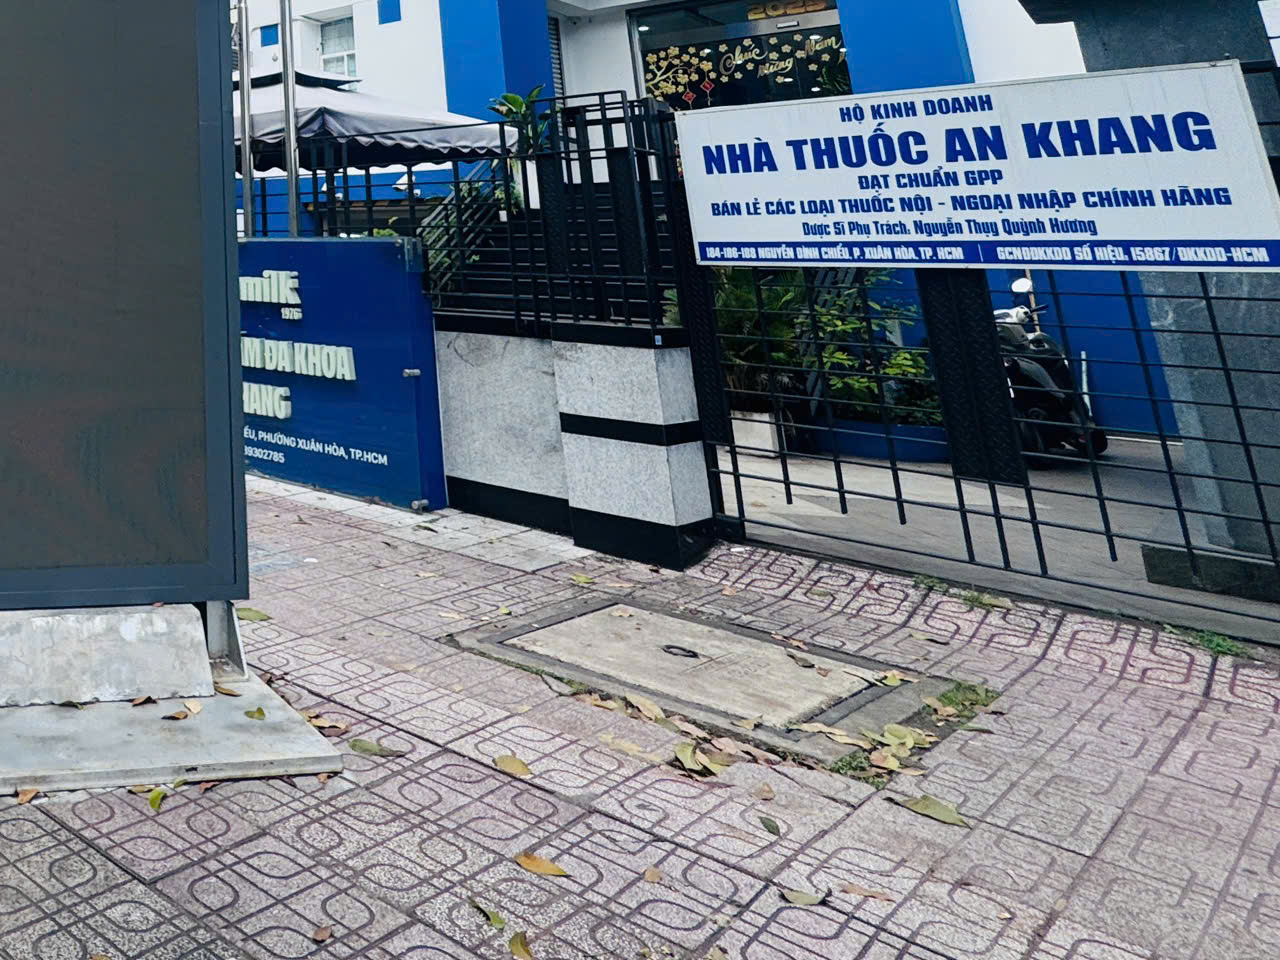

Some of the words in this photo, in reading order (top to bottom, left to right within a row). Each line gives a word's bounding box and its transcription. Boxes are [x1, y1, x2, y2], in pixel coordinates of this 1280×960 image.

[839, 102, 865, 125] HỘ
[870, 101, 918, 120] KINH
[922, 94, 994, 116] DOANH
[702, 136, 779, 175] NHÀ
[785, 122, 929, 170] THUỐC
[945, 125, 1008, 163] AN
[1020, 111, 1217, 159] KHANG
[857, 174, 891, 193] ĐẠT
[895, 165, 960, 188] CHUẨN
[964, 169, 1004, 186] GPP
[711, 200, 742, 216] BÁN
[746, 197, 762, 216] LẺ
[764, 198, 796, 215] CÁC
[800, 199, 836, 217] LOẠI
[838, 192, 895, 214] THUỐC
[898, 193, 933, 216] NỘI
[950, 193, 1013, 214] NGOẠI
[1017, 189, 1077, 213] NHẬP
[1082, 187, 1156, 208] CHÍNH
[1161, 185, 1233, 207] HÃNG
[802, 222, 831, 239] Dược
[848, 220, 870, 239] Phụ
[913, 217, 964, 238] Nguyễn
[1001, 218, 1047, 237] Quỳnh
[1049, 217, 1098, 237] Hương
[757, 243, 795, 259] NGUYỄN
[863, 245, 893, 260] XUÂN
[1073, 243, 1093, 261] SỐ
[281, 307, 303, 320] 1976
[263, 339, 295, 372] ĐA
[294, 342, 357, 381] KHOA
[258, 430, 297, 448] PHƯỜNG
[296, 438, 324, 453] XUÂN
[324, 442, 349, 460] HÒA,
[349, 447, 389, 466] TP.HCM
